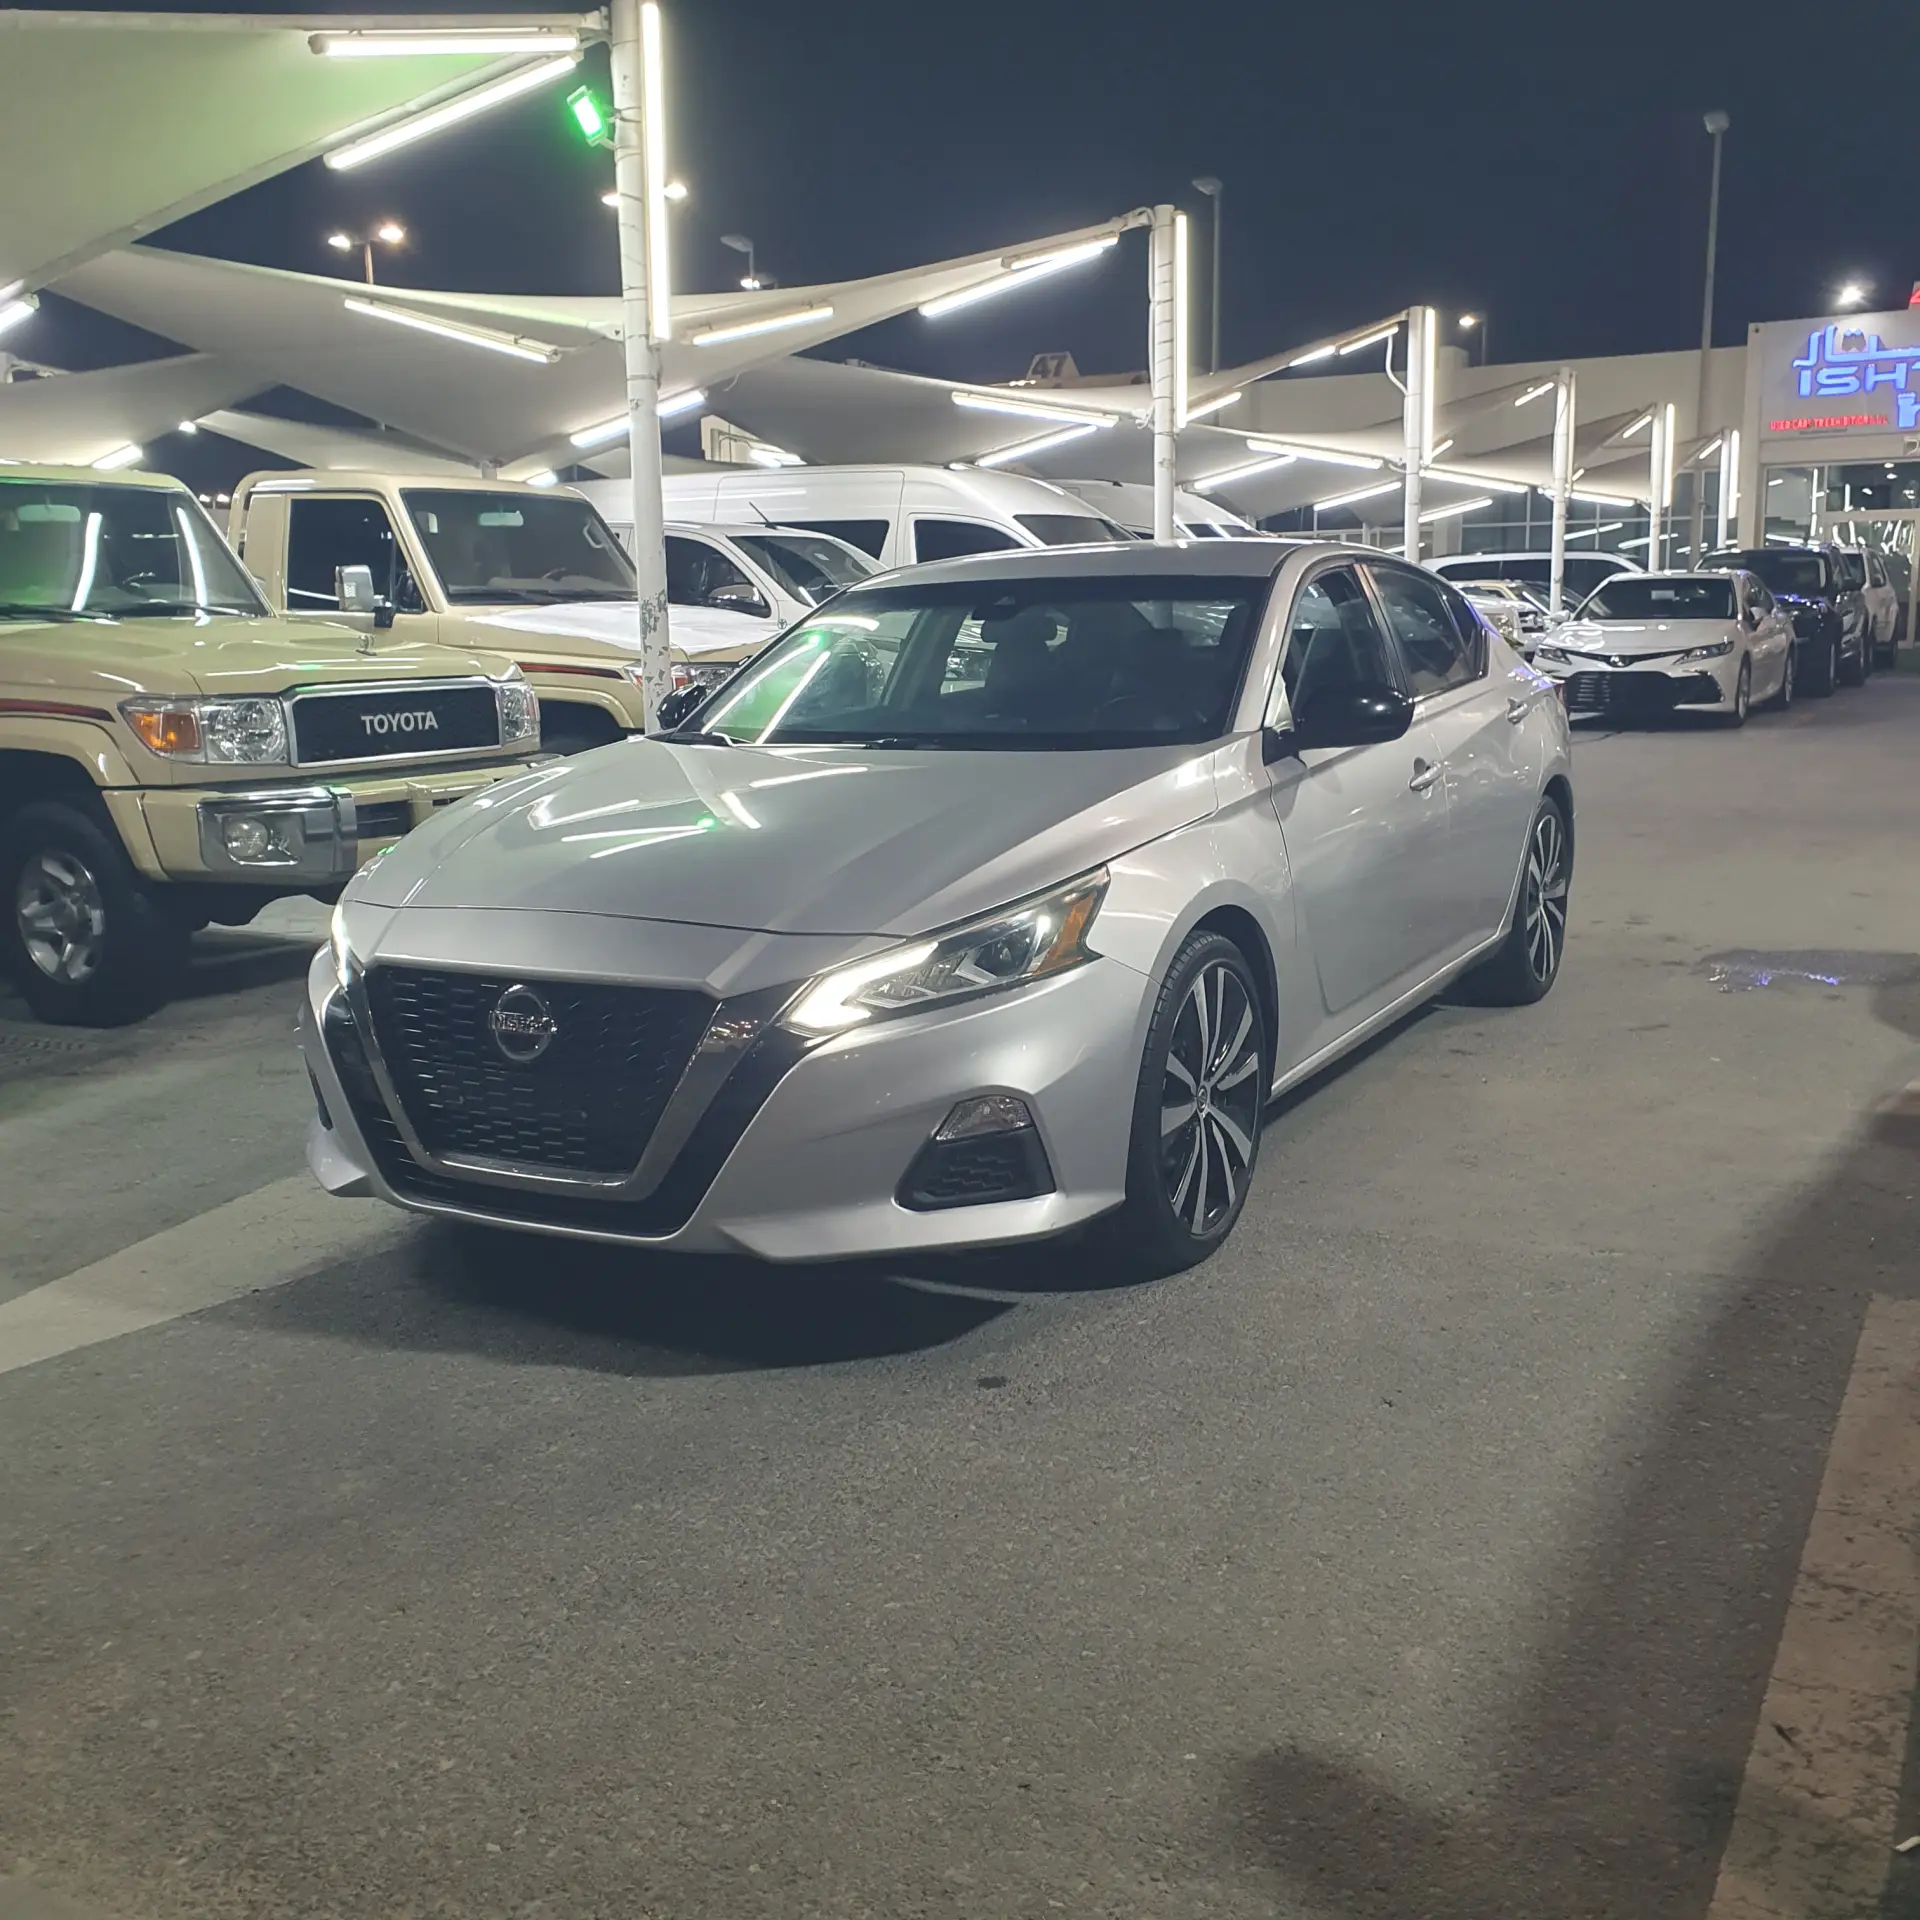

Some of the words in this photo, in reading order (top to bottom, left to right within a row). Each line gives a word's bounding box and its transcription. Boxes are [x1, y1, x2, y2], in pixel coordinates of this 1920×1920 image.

[1031, 355, 1068, 378] 47
[361, 710, 439, 735] TOYOTA
[492, 1010, 555, 1034] NISSAN
